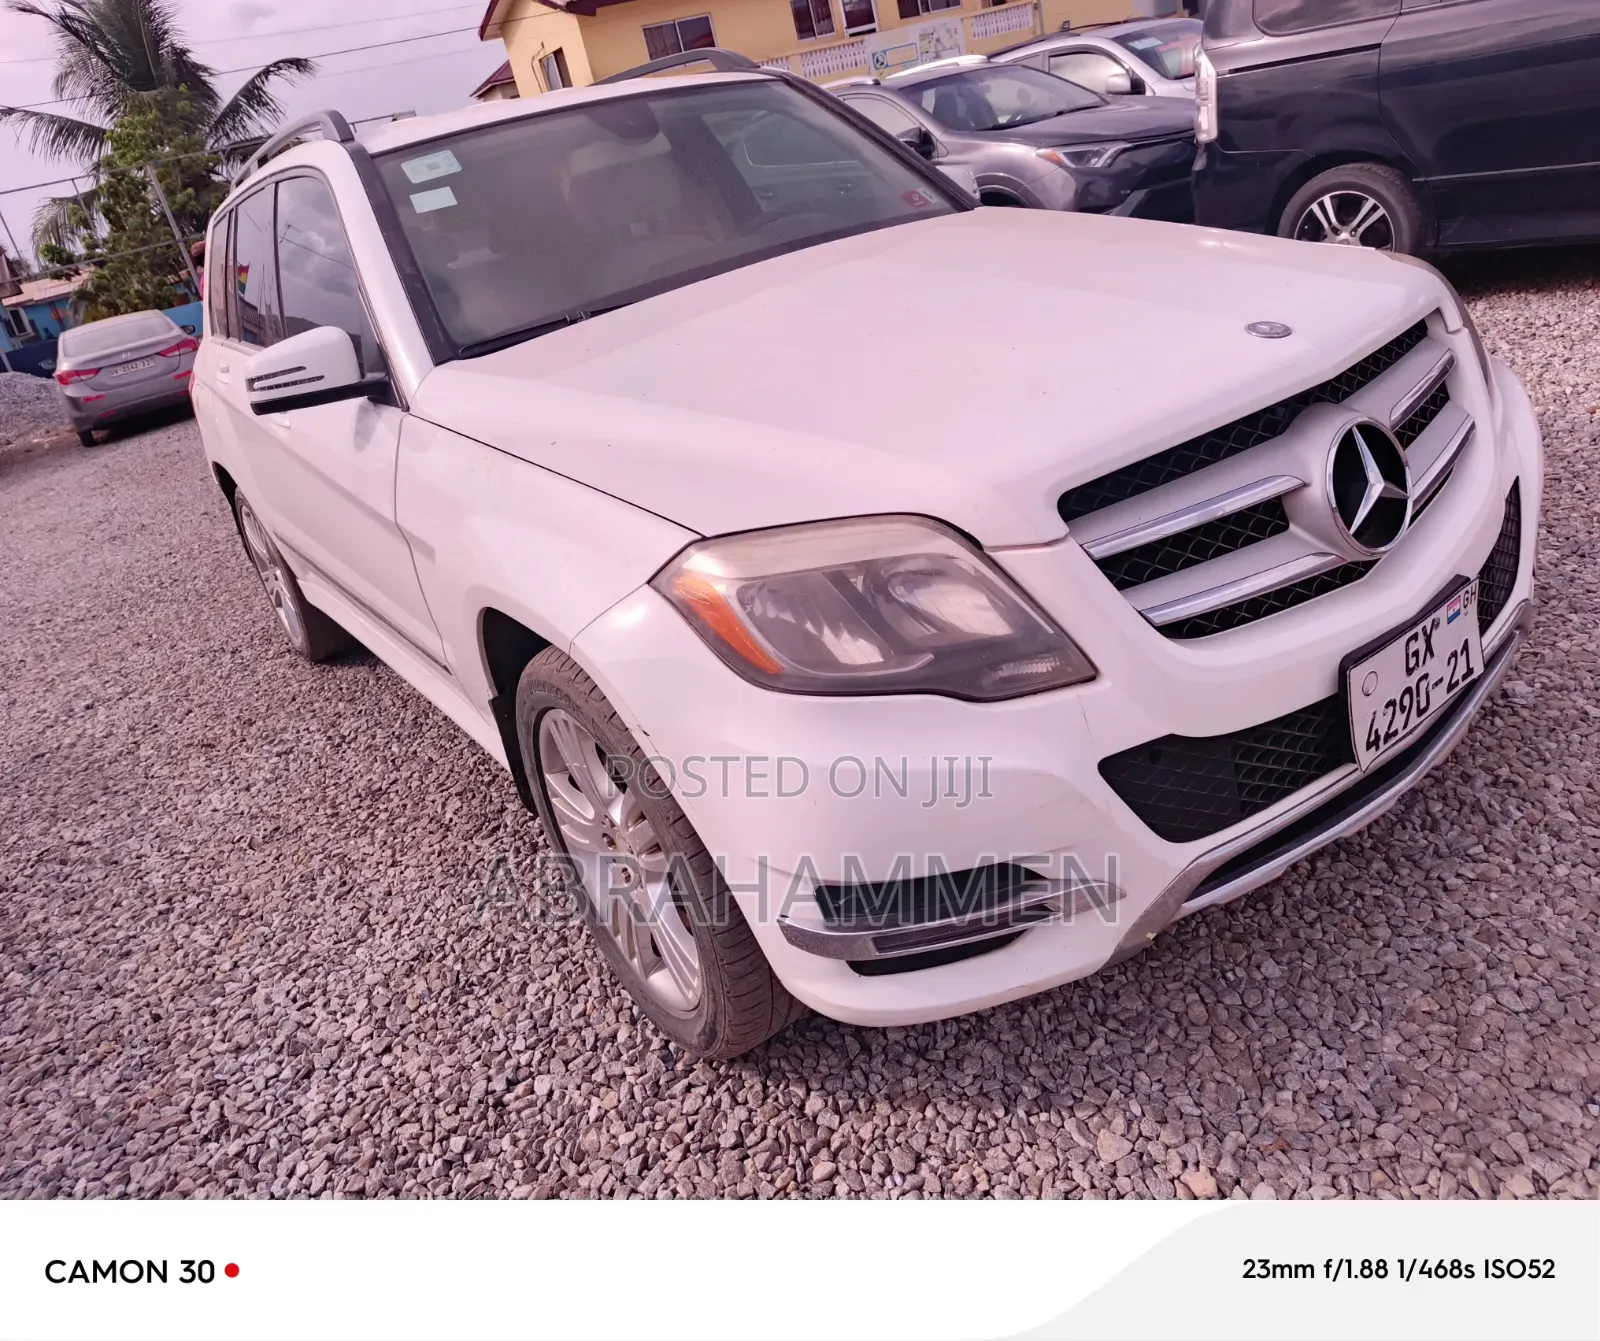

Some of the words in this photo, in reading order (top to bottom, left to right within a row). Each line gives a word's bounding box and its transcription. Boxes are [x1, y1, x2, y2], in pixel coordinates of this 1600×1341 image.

[1462, 582, 1477, 609] GH
[1404, 617, 1436, 677] GX
[1365, 638, 1474, 752] 4290-21
